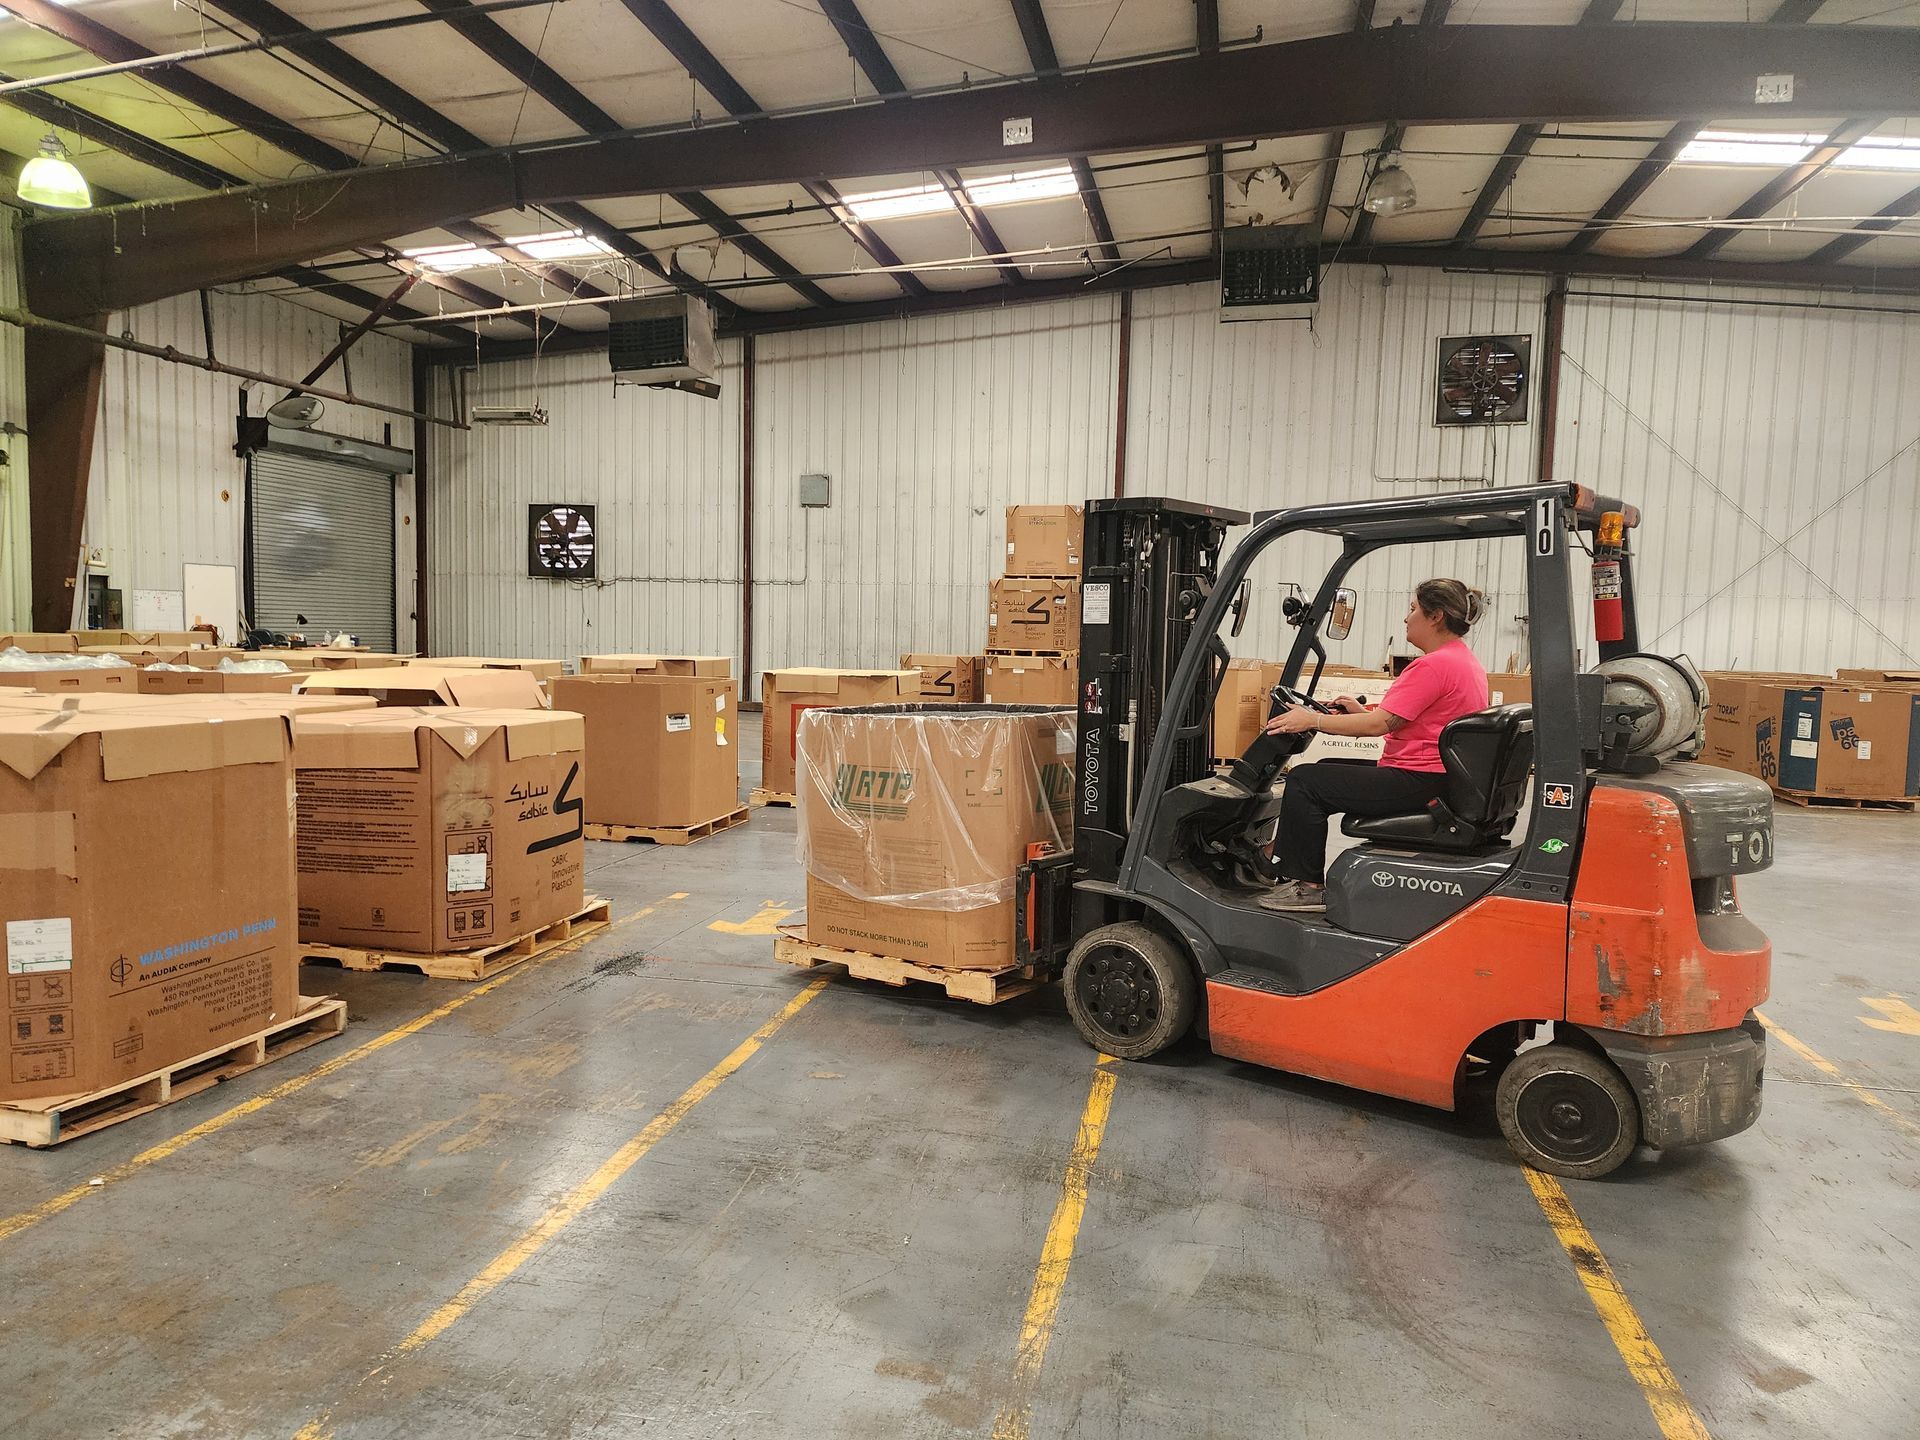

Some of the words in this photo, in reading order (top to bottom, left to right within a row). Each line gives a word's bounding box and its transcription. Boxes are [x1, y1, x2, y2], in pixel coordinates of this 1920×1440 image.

[1538, 500, 1551, 555] 10
[1085, 584, 1109, 592] VESCO
[1321, 740, 1352, 748] ACRYLIC
[1084, 728, 1100, 815] TOYOTA
[504, 781, 548, 806] سابك
[856, 770, 913, 799] RTP
[1547, 787, 1570, 805] SAS
[518, 802, 549, 822] sabic
[551, 852, 568, 867] SABIC
[1397, 875, 1464, 896] TOYOTA
[139, 928, 239, 966] WASHINGTON
[242, 917, 276, 937] PENN
[827, 924, 835, 933] DO
[836, 927, 848, 935] NOT
[849, 929, 868, 939] STACK
[869, 933, 887, 942] MORE
[889, 936, 906, 945] THAN
[912, 940, 929, 948] HIGH
[139, 974, 150, 982] An
[152, 965, 178, 978] AUDIA
[178, 956, 212, 970] Company
[161, 975, 202, 994] Washington
[204, 970, 222, 981] Penn
[223, 963, 245, 975] Plastic
[163, 993, 177, 1002] 450
[179, 983, 212, 998] Racetrack
[248, 968, 260, 976] Box
[192, 985, 236, 1002] Pennsylvania
[204, 996, 225, 1008] Phone
[213, 1006, 225, 1014] Fax
